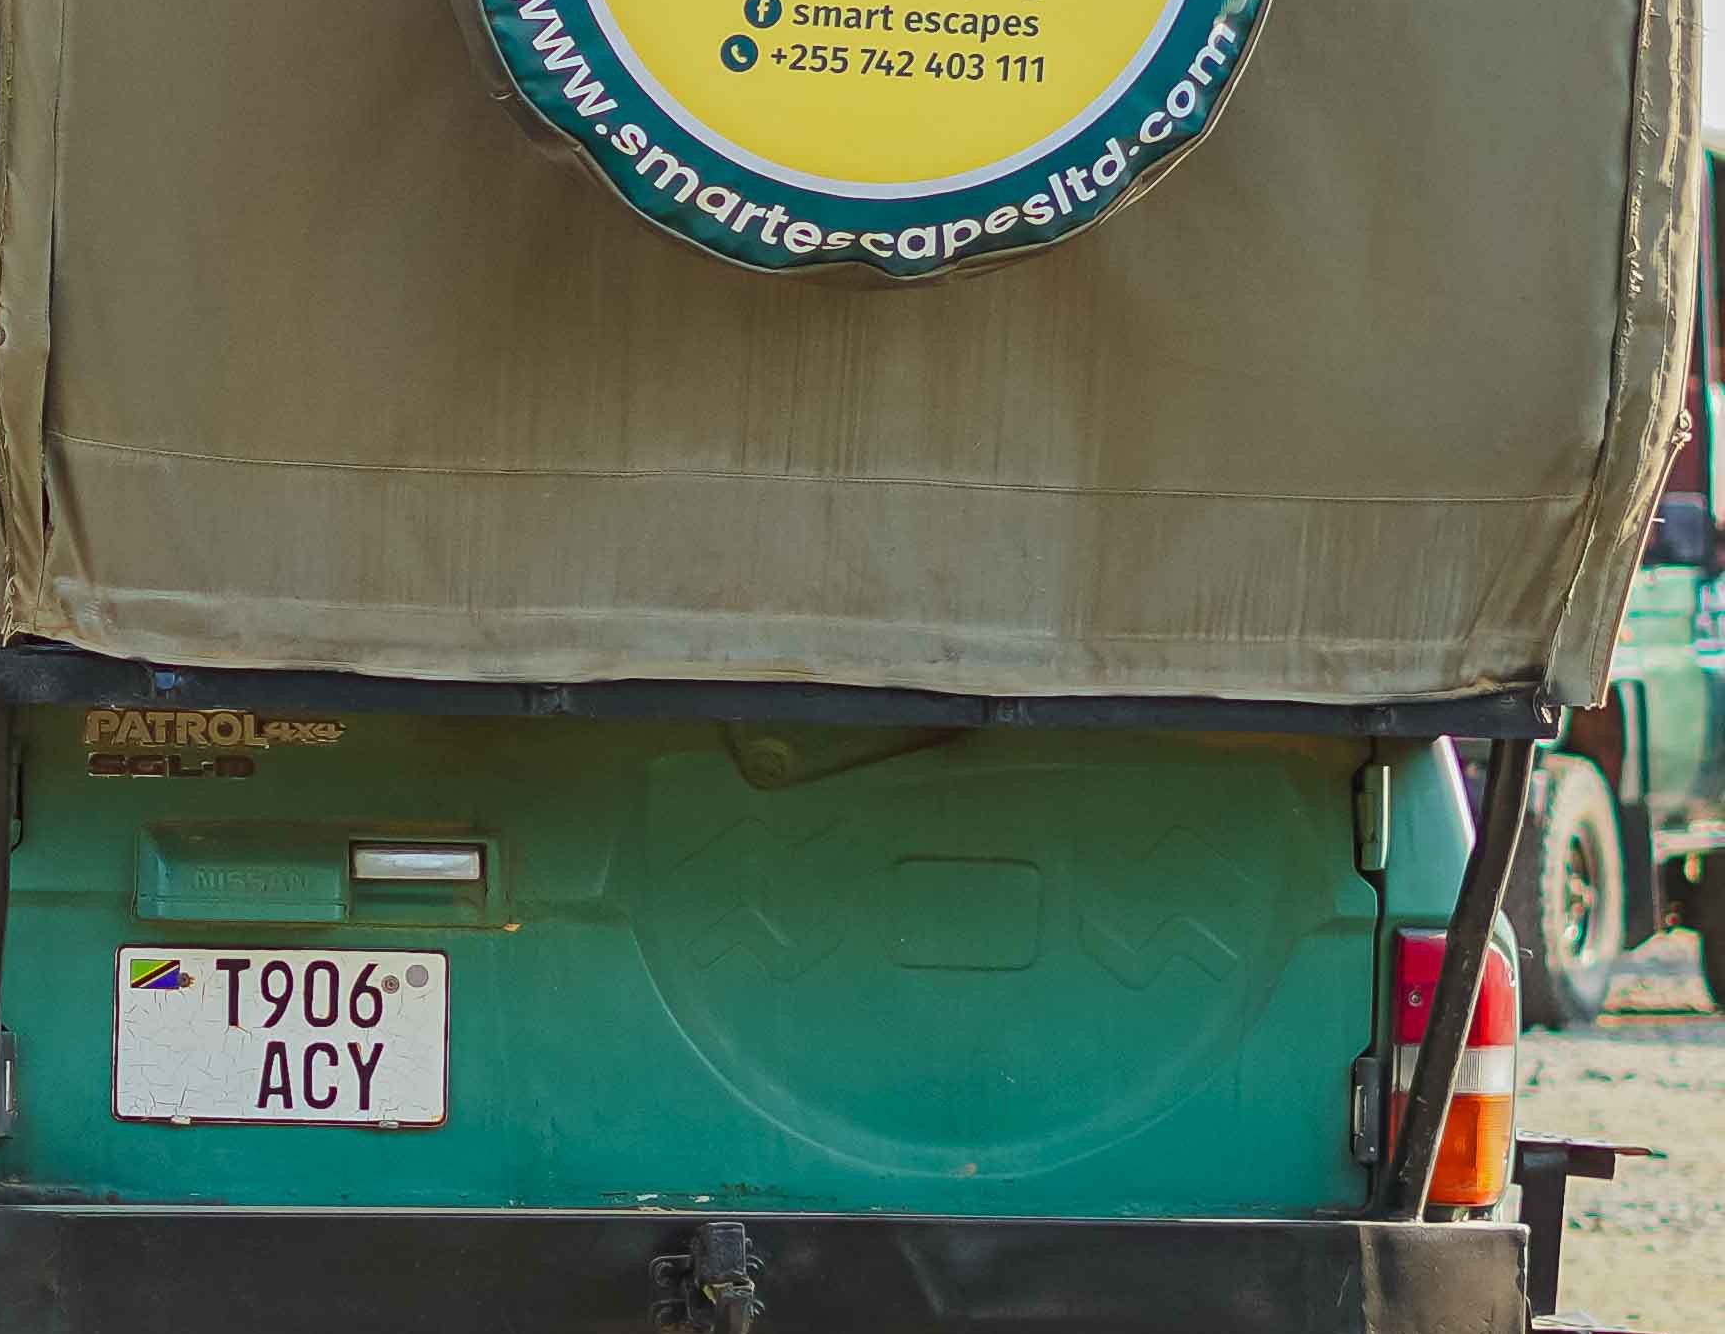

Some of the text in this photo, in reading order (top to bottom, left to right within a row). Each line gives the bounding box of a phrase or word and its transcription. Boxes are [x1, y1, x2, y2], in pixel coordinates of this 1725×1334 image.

[792, 4, 1039, 43] smart escapes
[770, 43, 1046, 83] +255 742 403 111
[86, 710, 268, 748] PATROL
[215, 958, 383, 1030] T906
[256, 1040, 384, 1111] ACY
